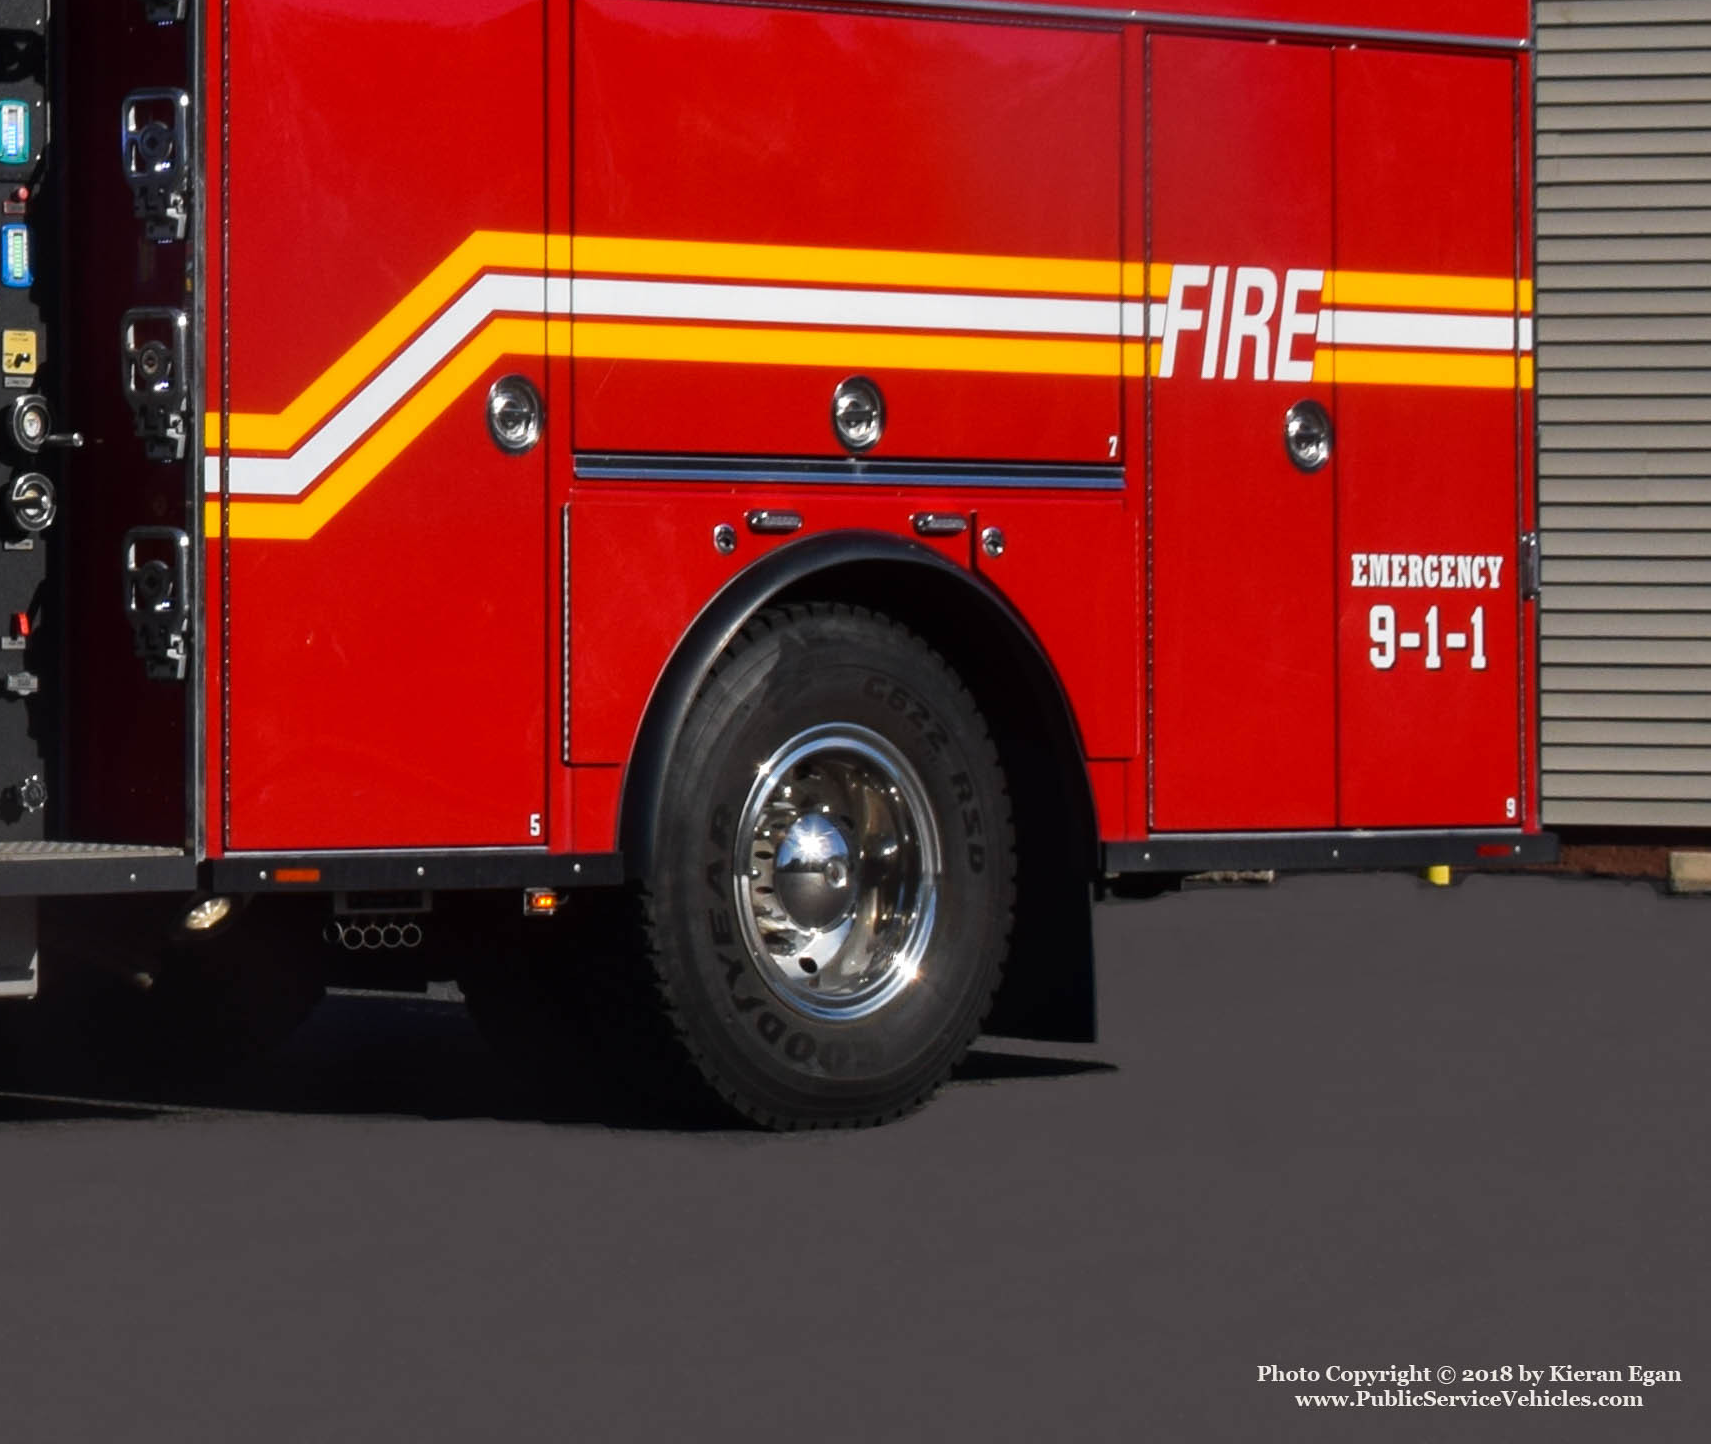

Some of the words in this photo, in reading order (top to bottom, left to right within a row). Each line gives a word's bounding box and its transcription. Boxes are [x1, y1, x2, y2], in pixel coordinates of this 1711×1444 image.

[1158, 264, 1325, 383] FIRE
[1108, 435, 1118, 458] 7
[1351, 554, 1505, 589] EMERGENCY
[1369, 604, 1487, 670] 9-1-1
[1506, 797, 1516, 818] 9
[530, 813, 541, 837] 5
